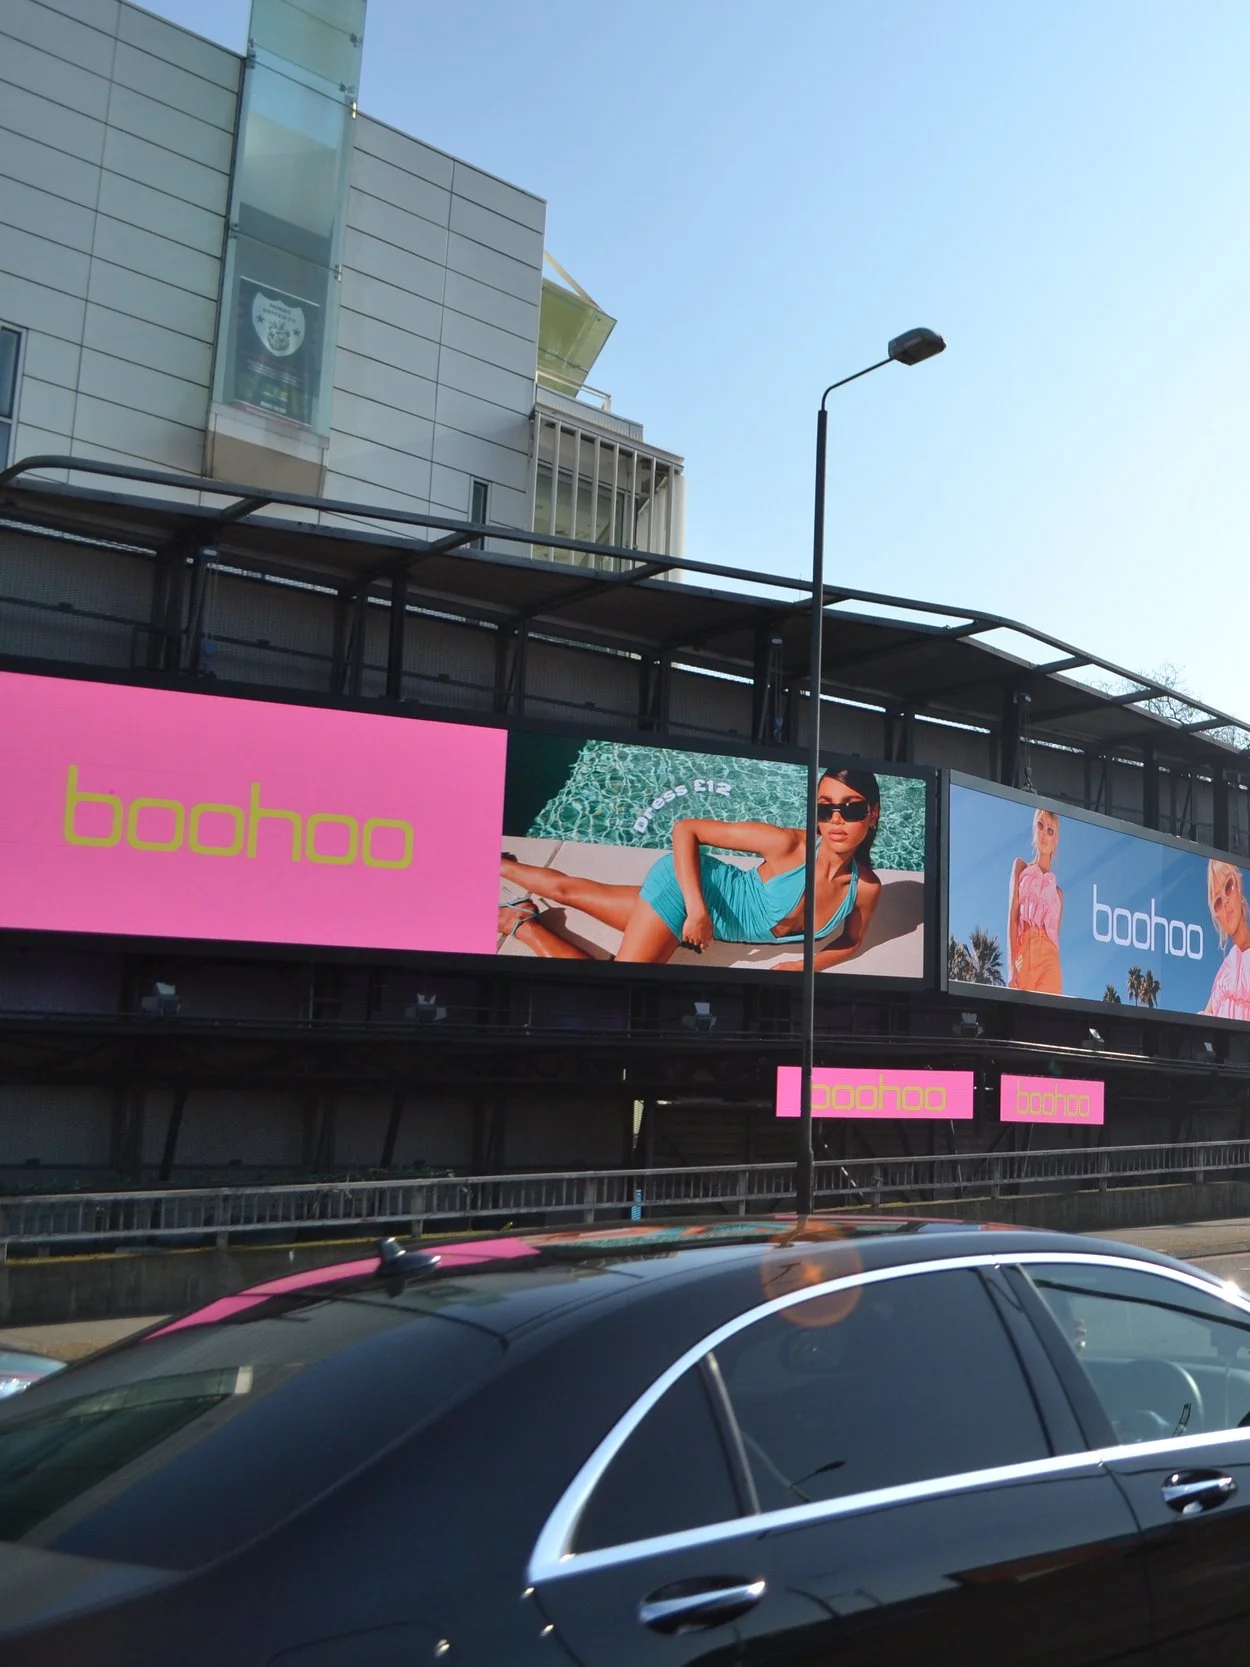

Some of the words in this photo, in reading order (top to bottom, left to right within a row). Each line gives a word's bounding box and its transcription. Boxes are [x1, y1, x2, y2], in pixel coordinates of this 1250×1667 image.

[64, 764, 414, 870] boohoo
[633, 784, 688, 833] Dress
[693, 779, 732, 797] £12
[1092, 885, 1204, 960] boohoo
[1017, 1080, 1090, 1117] boohoo
